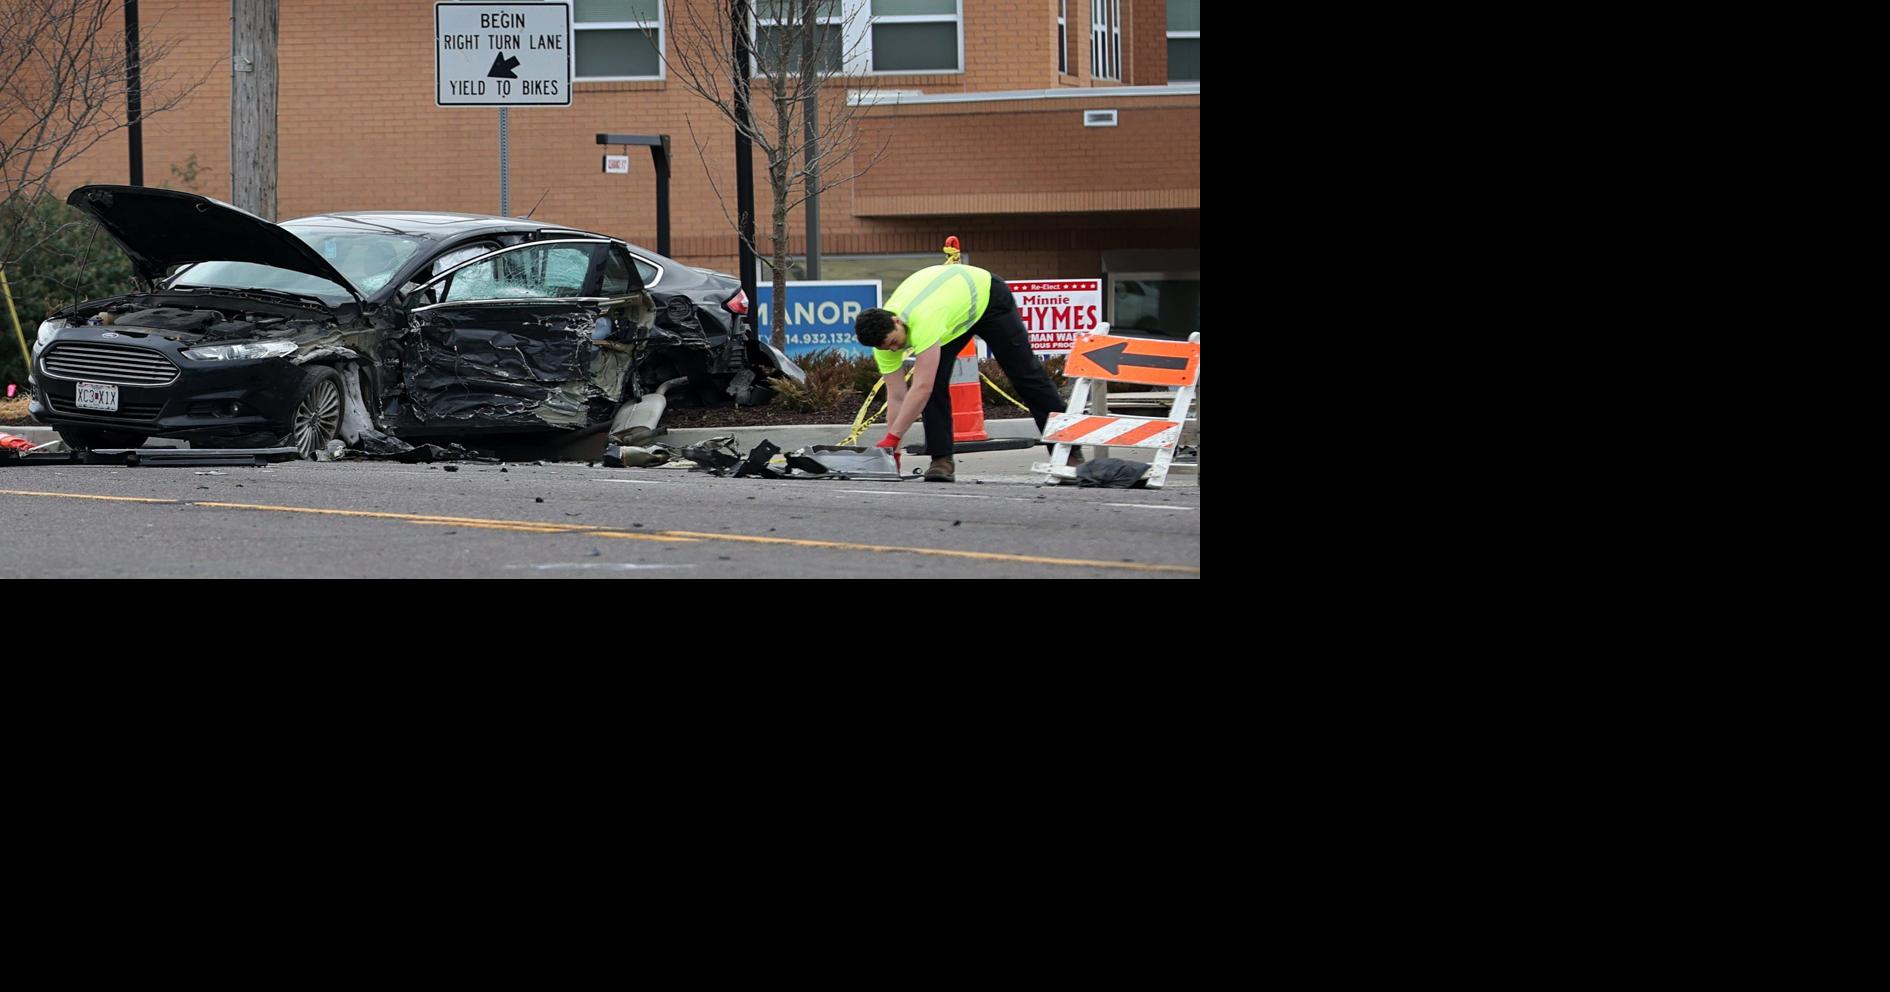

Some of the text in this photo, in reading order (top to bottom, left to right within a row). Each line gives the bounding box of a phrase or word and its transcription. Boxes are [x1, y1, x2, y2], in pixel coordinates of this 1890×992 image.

[481, 13, 525, 28] BEGIN
[444, 34, 562, 49] RIGHT TURN LANE
[449, 80, 558, 95] YIELD TO BIKES
[1023, 294, 1070, 305] Minnie
[1018, 305, 1097, 331] HYMES
